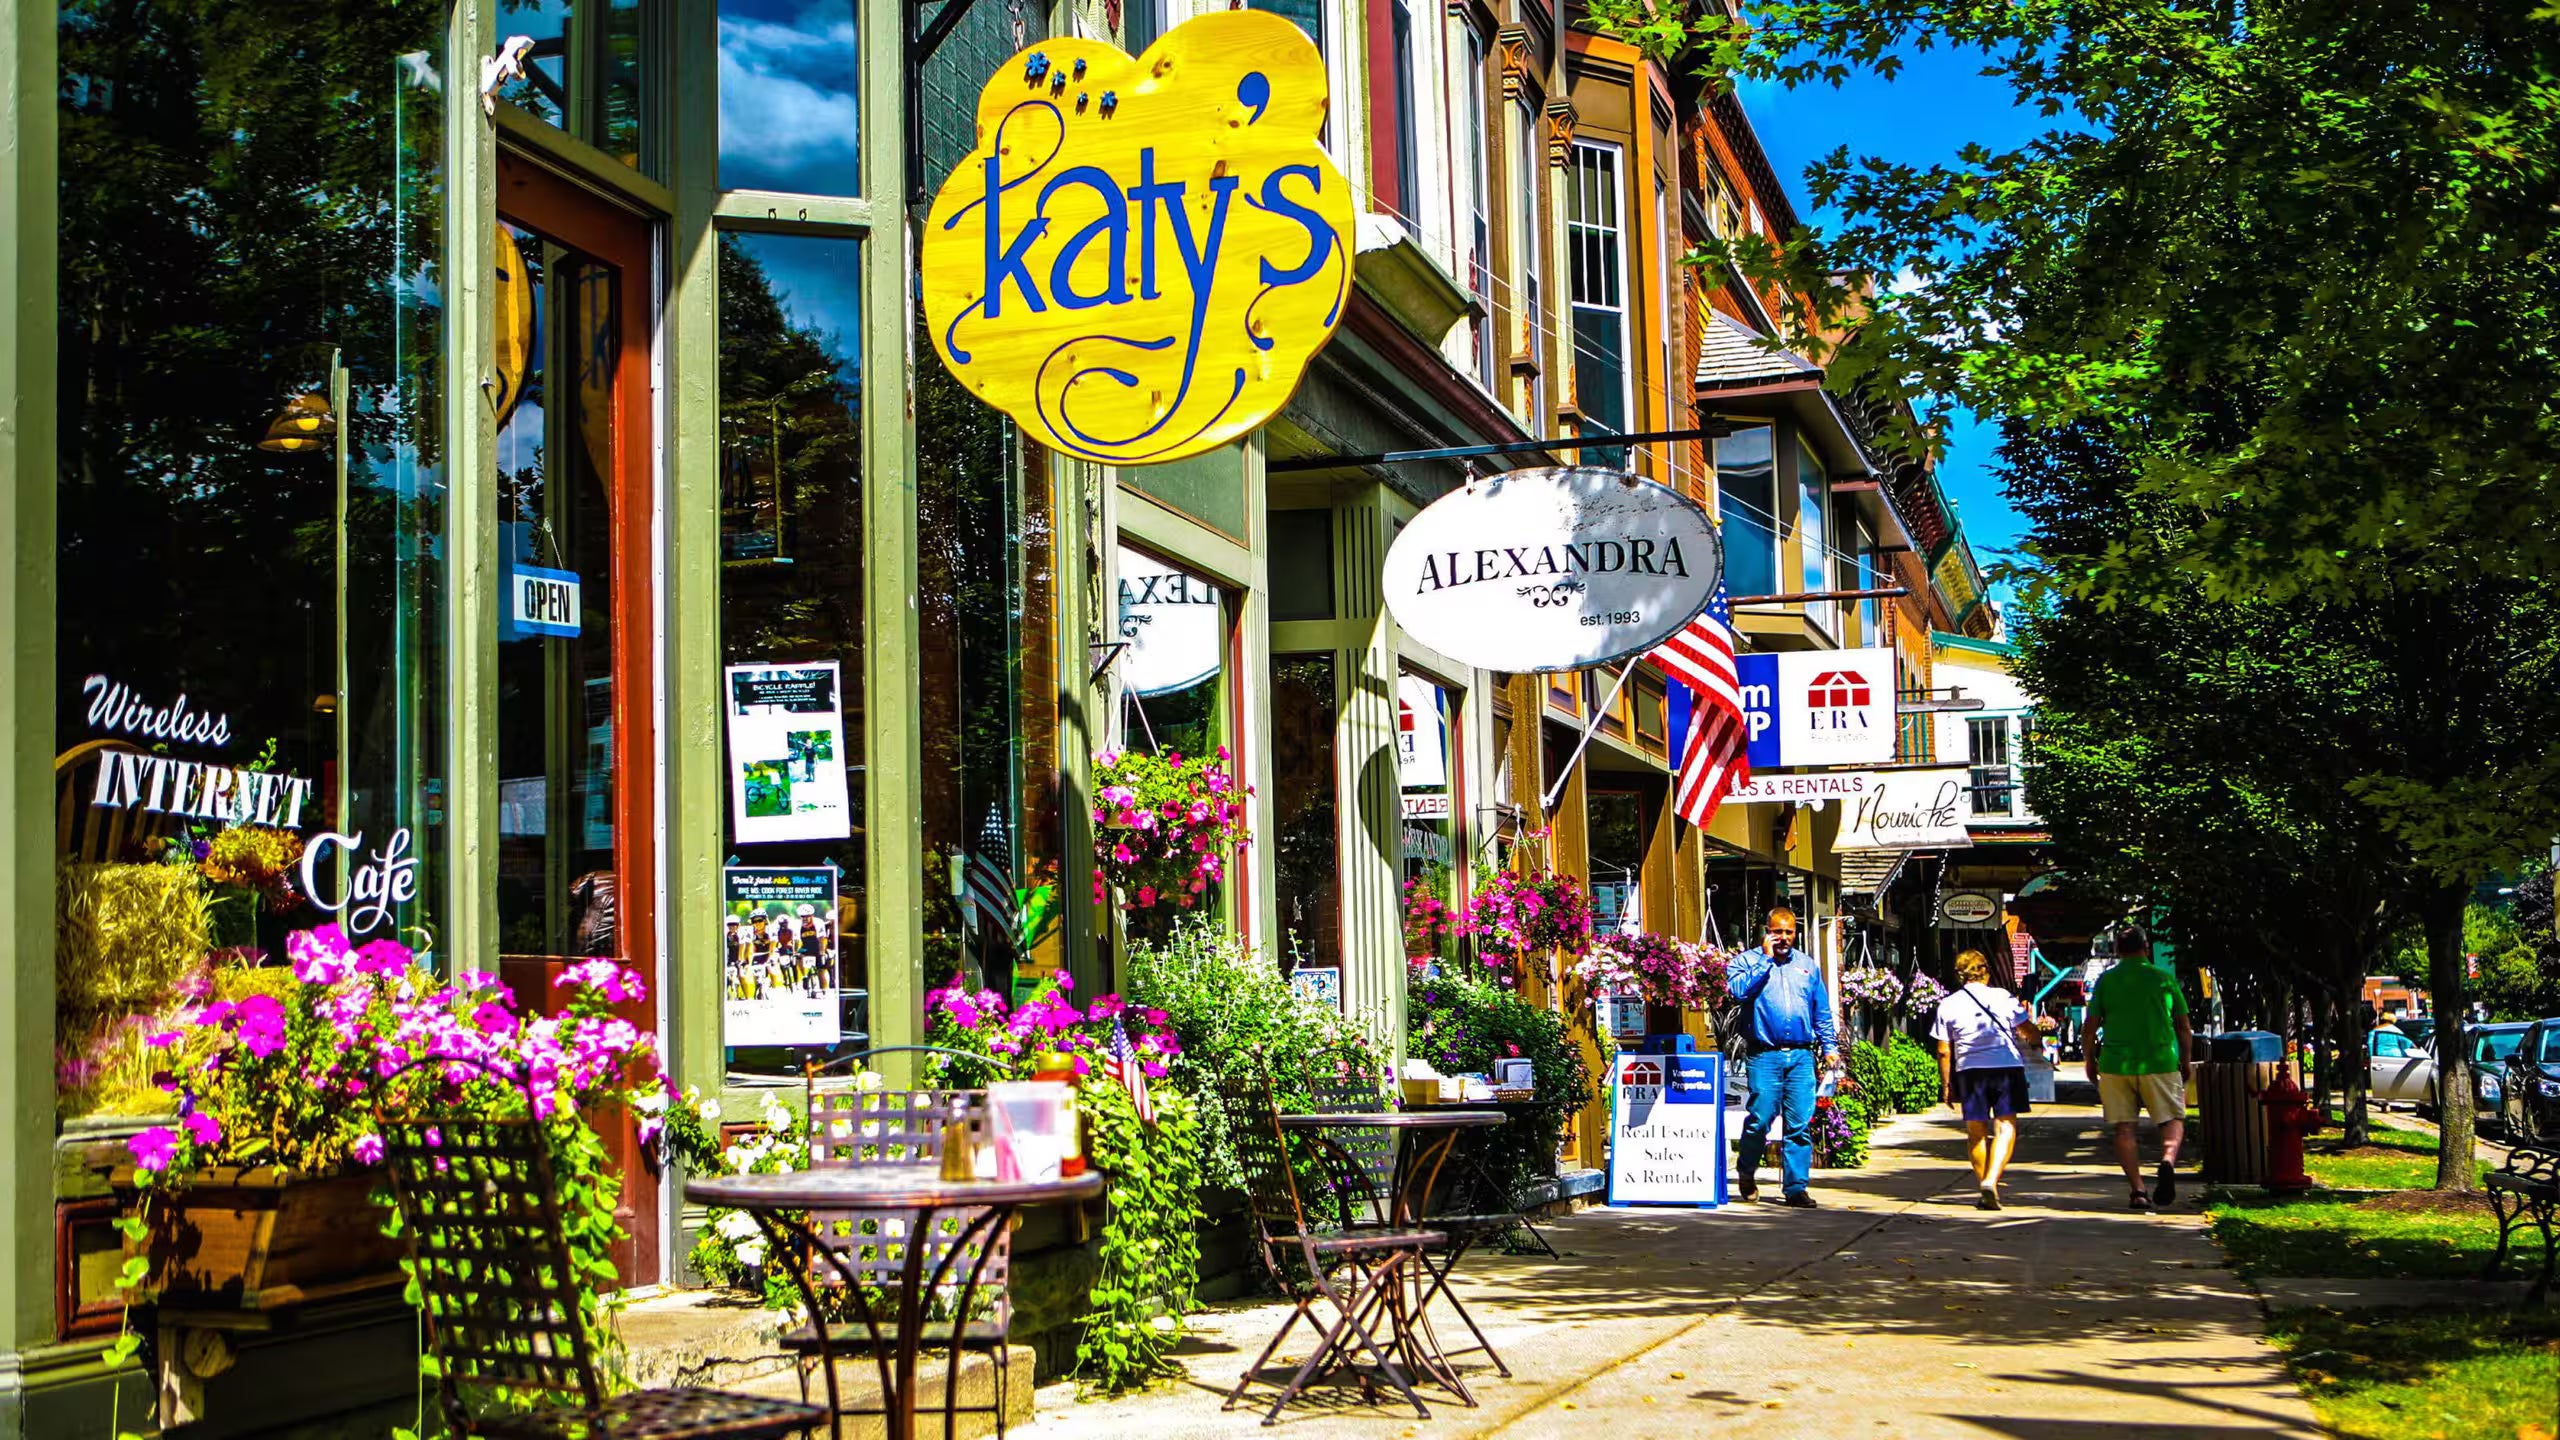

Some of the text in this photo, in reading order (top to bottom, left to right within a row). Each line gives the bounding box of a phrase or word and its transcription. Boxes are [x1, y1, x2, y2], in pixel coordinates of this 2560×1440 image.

[944, 72, 1345, 460] katy's
[1416, 536, 1690, 595] ALEXANDRA
[524, 579, 571, 623] OPEN
[83, 674, 231, 746] Wireless
[1811, 710, 1868, 729] ERA
[91, 749, 312, 829] INTERNET
[1765, 781, 1776, 795] &
[1782, 777, 1863, 795] RENTALS
[302, 828, 419, 934] Cafe
[732, 874, 754, 884] Don't
[754, 876, 772, 886] just
[1621, 1125, 1710, 1138] Real Estate
[1645, 1147, 1684, 1160] Sales
[1625, 1170, 1702, 1183] & Rentals
